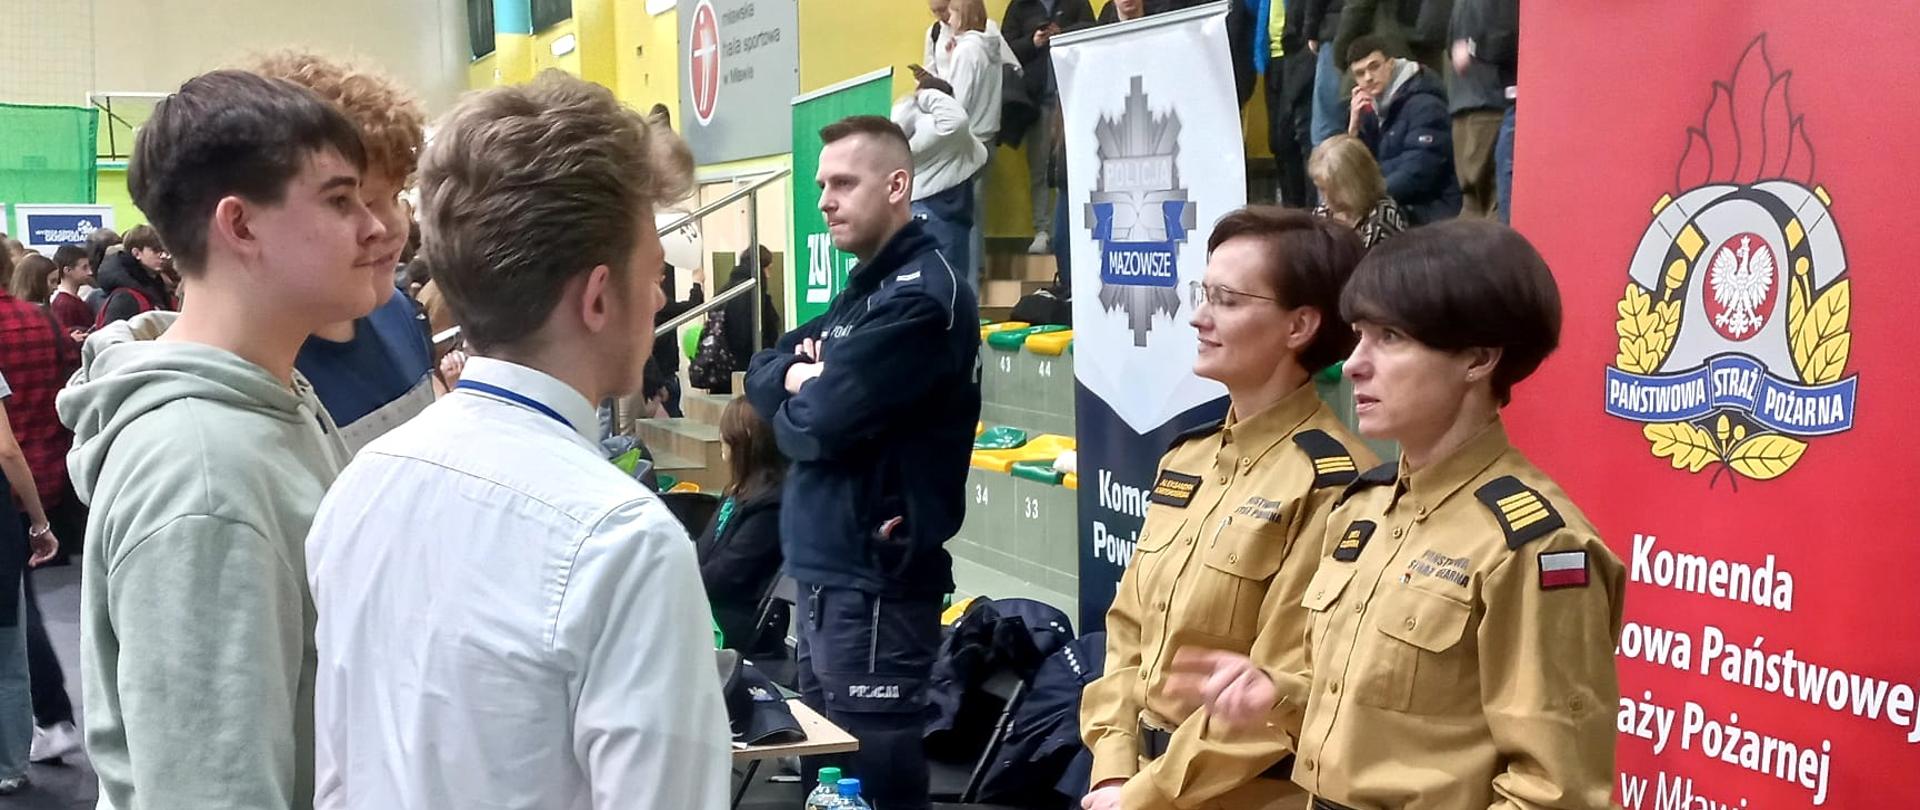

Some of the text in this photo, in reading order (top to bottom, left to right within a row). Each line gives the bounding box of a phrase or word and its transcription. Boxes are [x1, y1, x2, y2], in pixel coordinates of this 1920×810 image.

[743, 27, 781, 52] sportowa
[1104, 160, 1171, 188] POLICJA
[1109, 250, 1171, 277] MAZOWSZE
[1000, 356, 1011, 373] 43
[1039, 360, 1051, 377] 44
[1610, 377, 1706, 413] PAŃSTWOWA
[1714, 366, 1758, 401] STRAŻ
[1764, 384, 1844, 427] POŻARNA
[976, 483, 989, 506] 34
[1025, 496, 1039, 519] 33
[1098, 468, 1152, 518] Kome
[1093, 520, 1138, 568] Powi
[1630, 533, 1793, 612] Komenda
[1615, 622, 1691, 670] owa
[1617, 690, 1831, 806] aży Pożarnej
[1620, 772, 1648, 810] w
